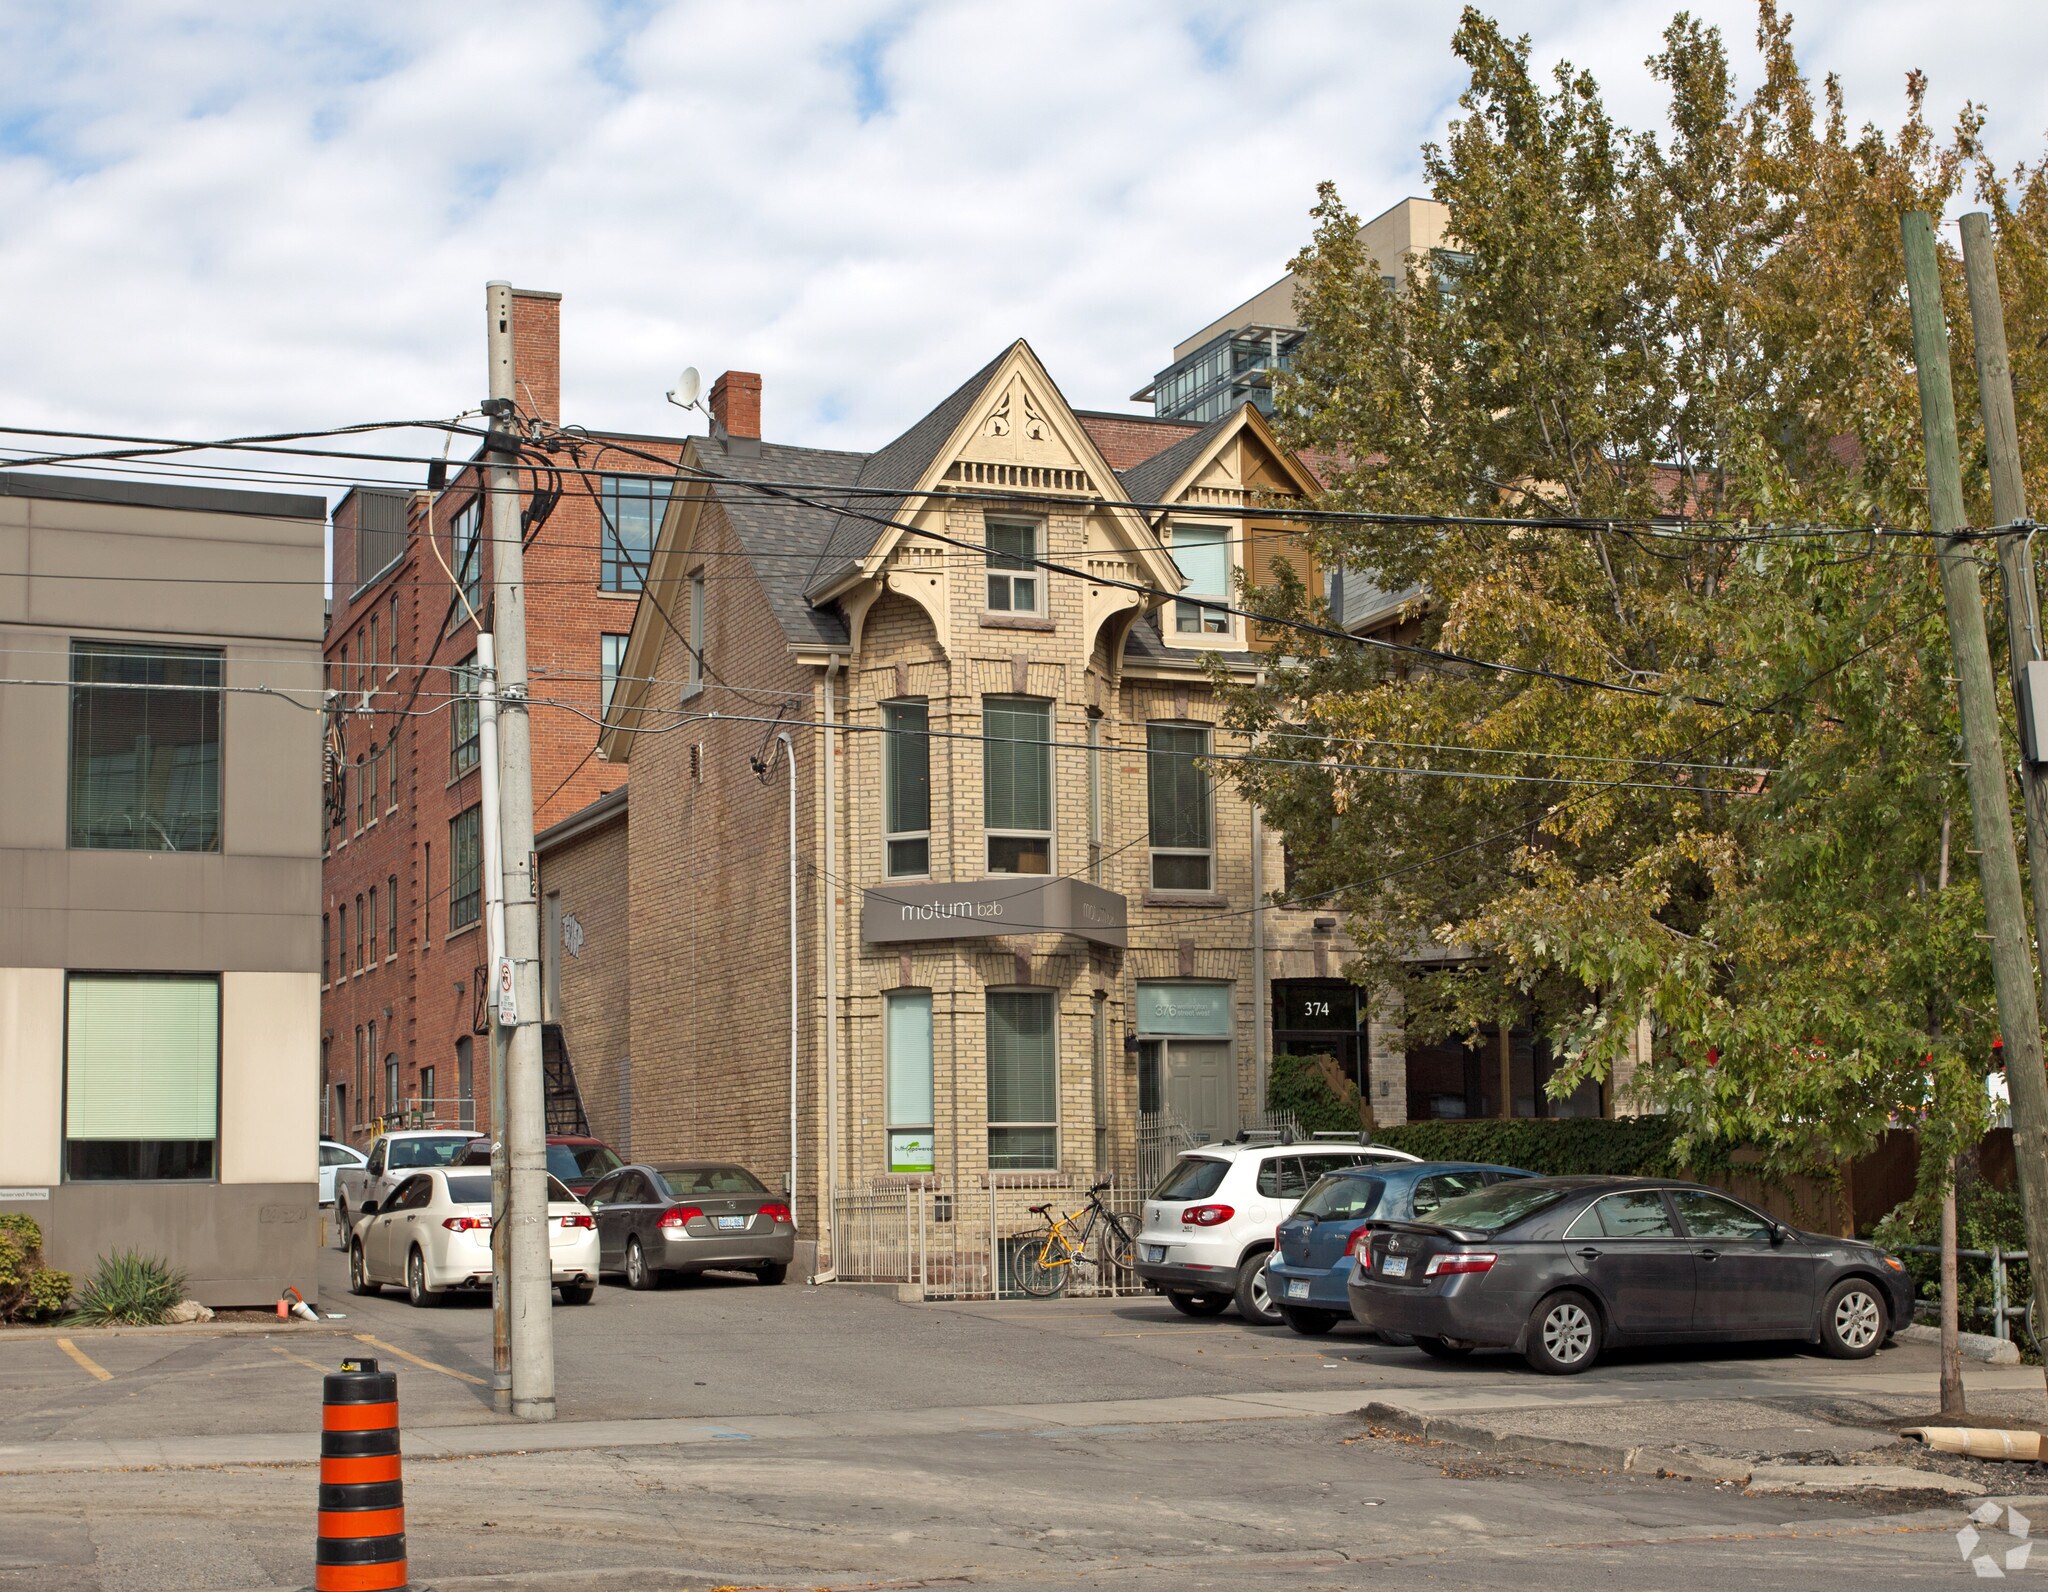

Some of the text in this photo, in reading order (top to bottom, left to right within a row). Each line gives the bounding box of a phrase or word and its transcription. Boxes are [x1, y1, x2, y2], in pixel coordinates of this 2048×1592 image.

[902, 900, 1003, 921] motum b2b
[1155, 1003, 1177, 1017] 376
[1304, 1001, 1330, 1016] 374
